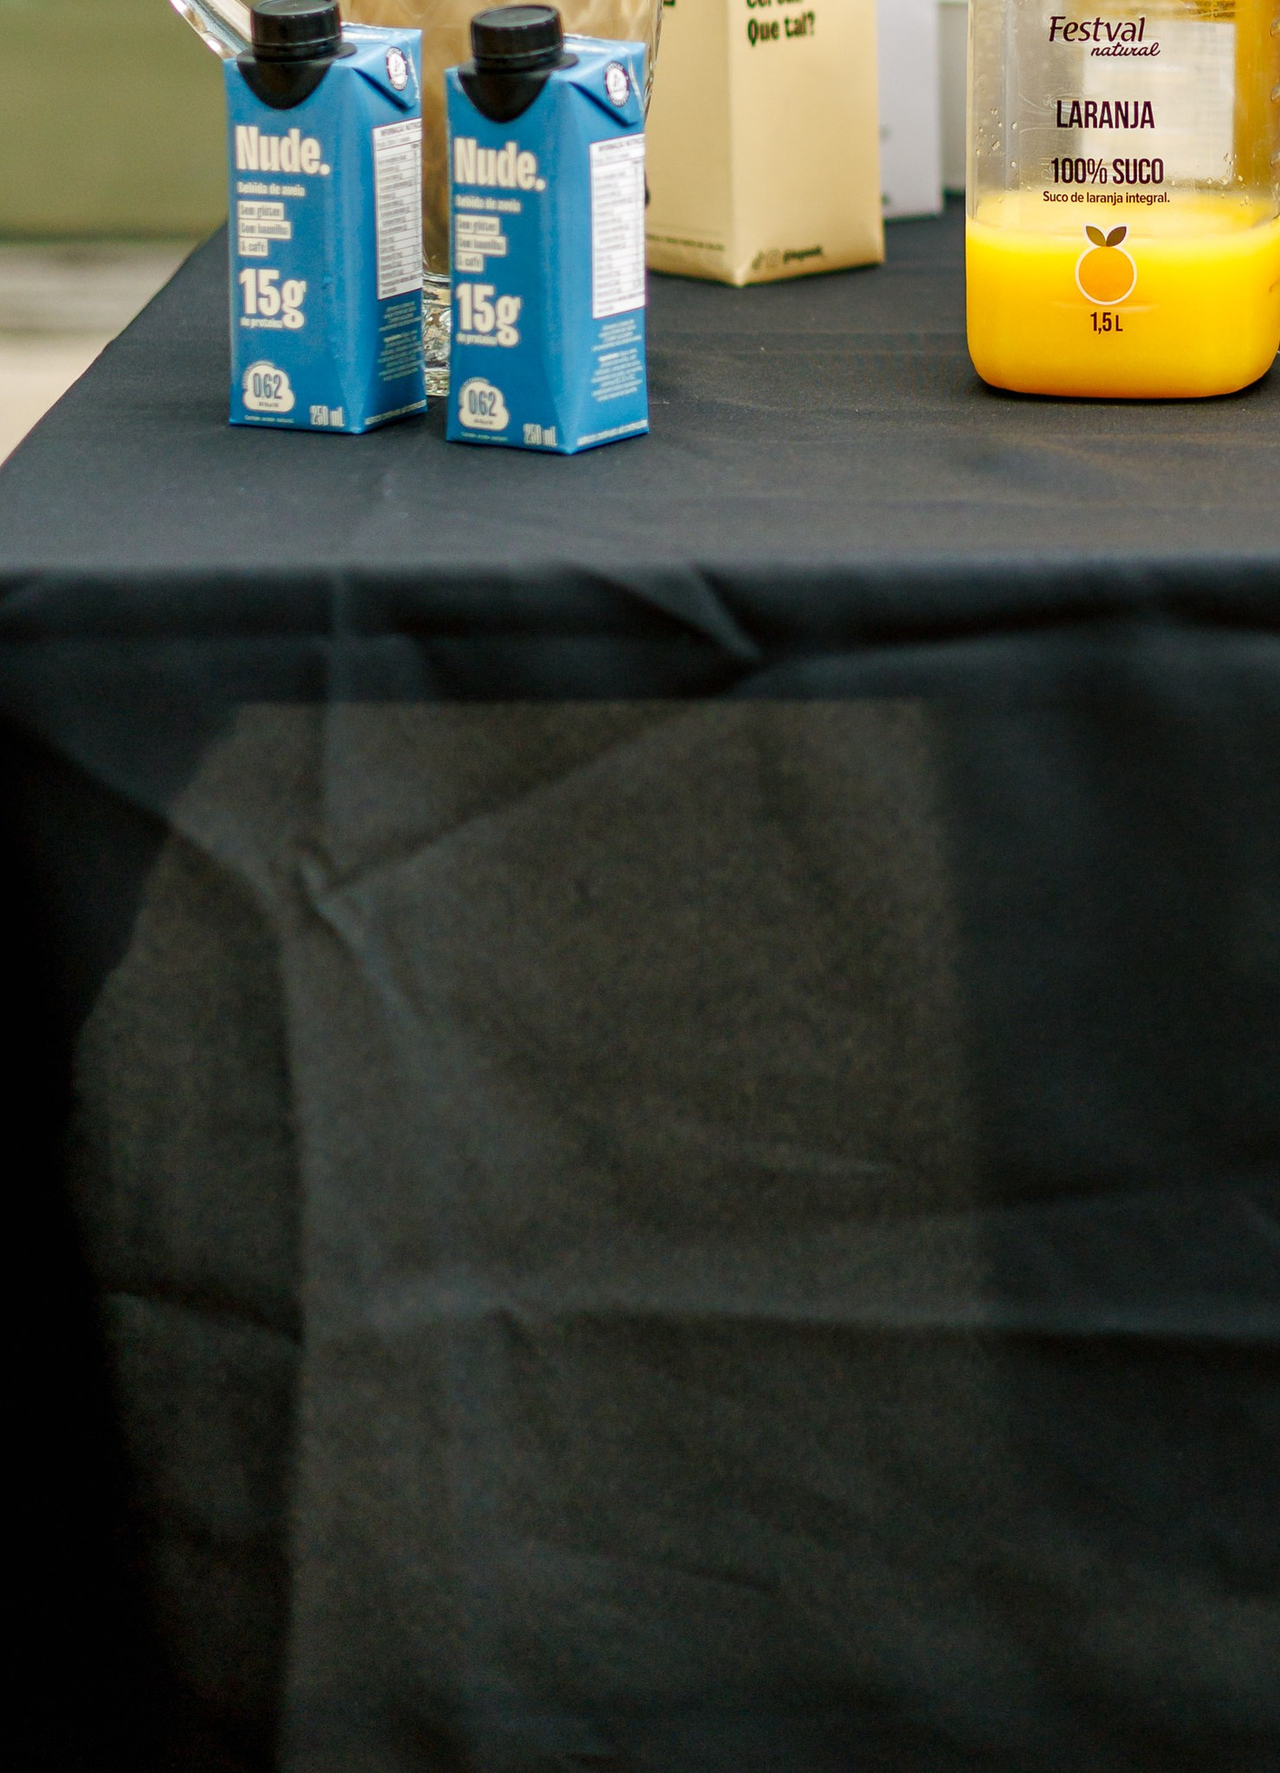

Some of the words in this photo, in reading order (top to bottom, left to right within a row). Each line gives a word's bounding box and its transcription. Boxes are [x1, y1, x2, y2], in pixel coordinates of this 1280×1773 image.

[747, 17, 780, 47] Que
[784, 11, 816, 38] tal?
[1048, 16, 1146, 42] Festval
[1090, 42, 1161, 57] natural
[1056, 99, 1155, 129] LARANJA
[236, 125, 332, 175] Nude.
[454, 137, 546, 192] Nude.
[1051, 157, 1108, 185] 100%
[1112, 158, 1165, 185] SUCO
[1043, 190, 1069, 203] Suco
[1071, 191, 1084, 203] de
[1086, 192, 1124, 206] laranja
[1125, 192, 1171, 205] integral.
[239, 268, 307, 329] 15g
[456, 283, 522, 347] 15g
[1090, 311, 1113, 335] 1,5
[1115, 314, 1124, 332] L
